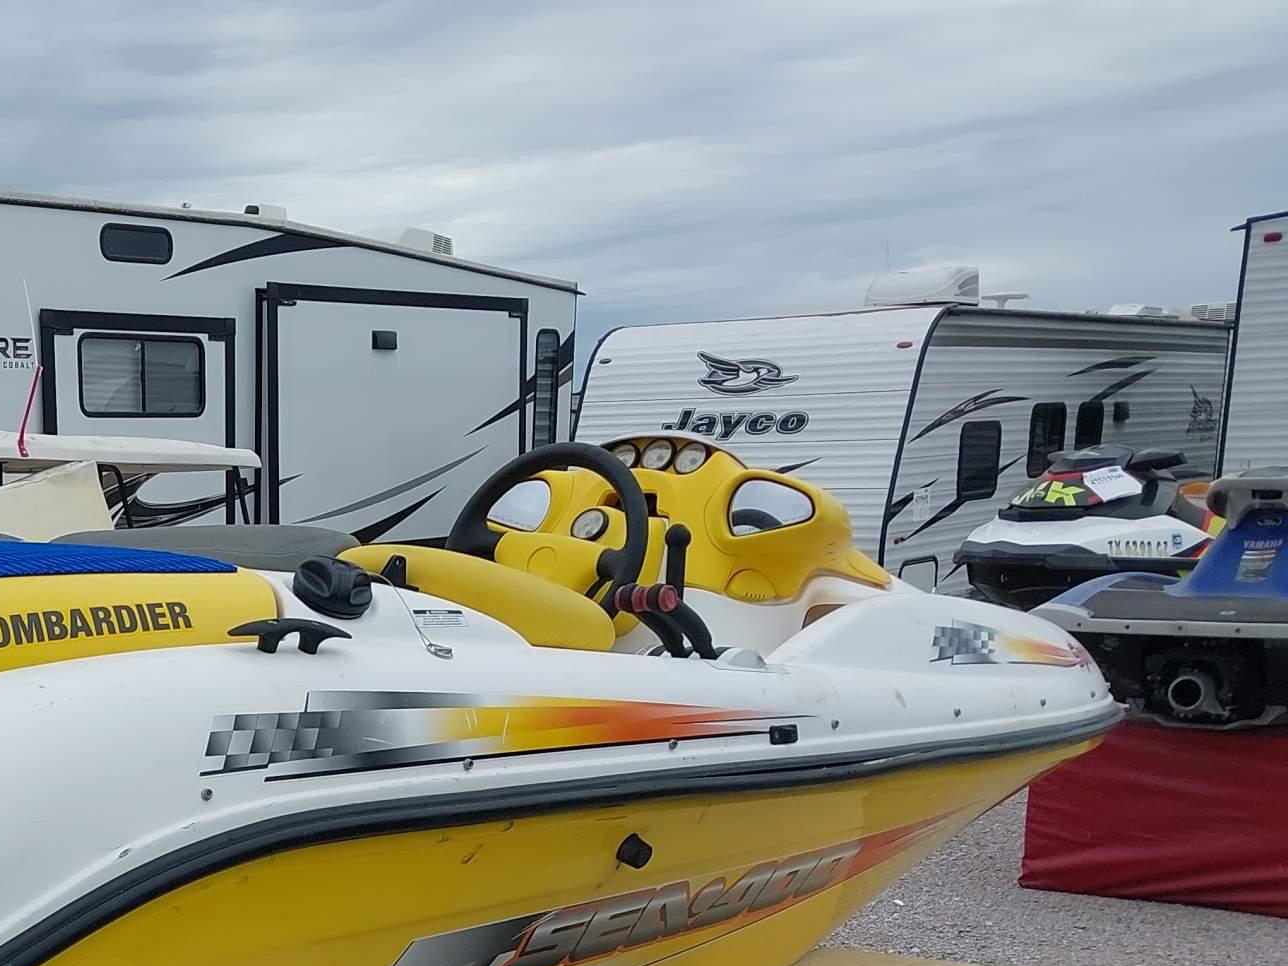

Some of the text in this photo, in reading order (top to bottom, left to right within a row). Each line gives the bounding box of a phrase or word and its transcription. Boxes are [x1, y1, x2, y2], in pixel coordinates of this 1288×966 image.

[2, 361, 35, 370] COBALT
[661, 407, 810, 441] Jayco
[1107, 540, 1121, 557] TX
[1243, 538, 1284, 550] YAMAHA
